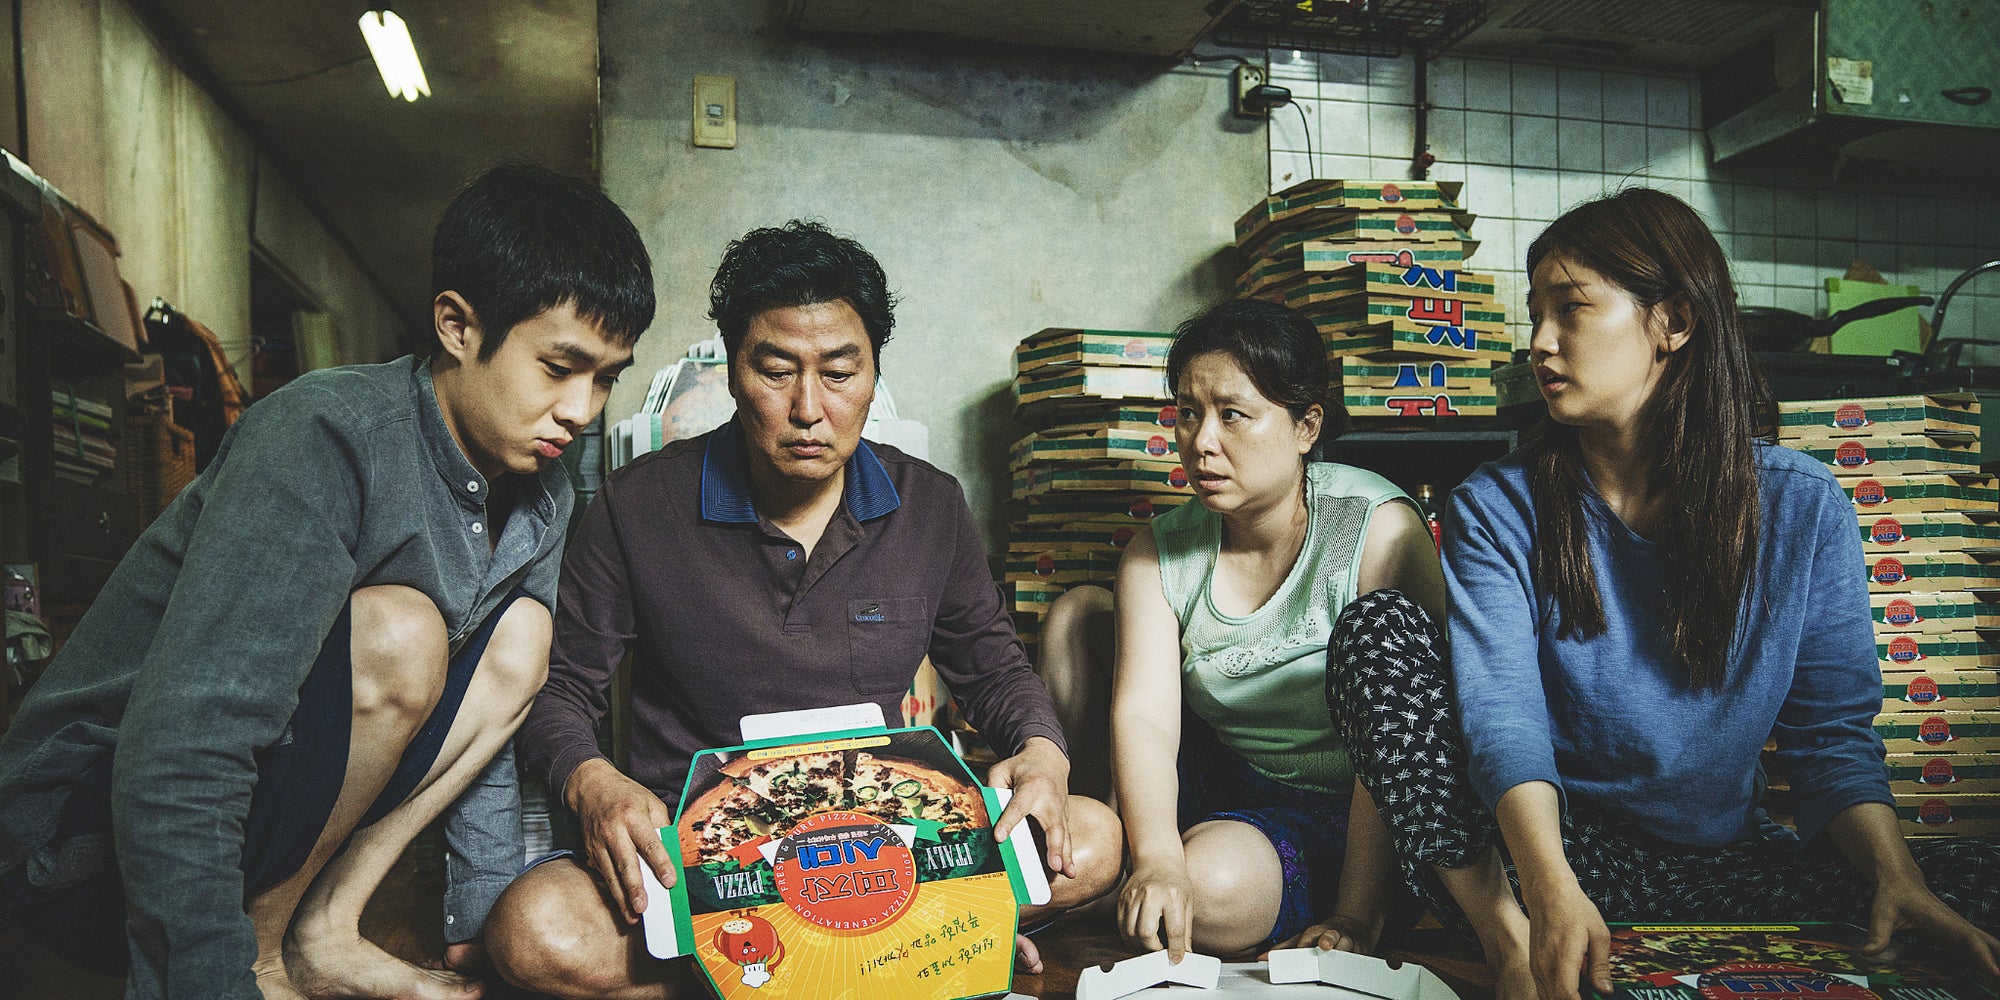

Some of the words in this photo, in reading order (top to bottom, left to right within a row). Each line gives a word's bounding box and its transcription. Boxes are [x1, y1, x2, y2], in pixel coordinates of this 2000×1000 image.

[777, 856, 790, 893] FRESH
[787, 819, 816, 841] PURE
[819, 812, 857, 823] PIZZA
[796, 836, 887, 871] 시대
[872, 822, 905, 848] SINCE
[902, 853, 911, 877] 2010
[925, 842, 974, 872] ITALY
[713, 870, 765, 901] PIZZA
[799, 868, 900, 904] 피자
[794, 903, 878, 930] GENERATION
[881, 890, 909, 917] PIZZA
[910, 932, 937, 949] 양과
[940, 910, 980, 941] 푸짐한
[859, 943, 909, 976] 맛까지!!
[959, 938, 993, 964] 신선한
[917, 956, 955, 979] 재료와
